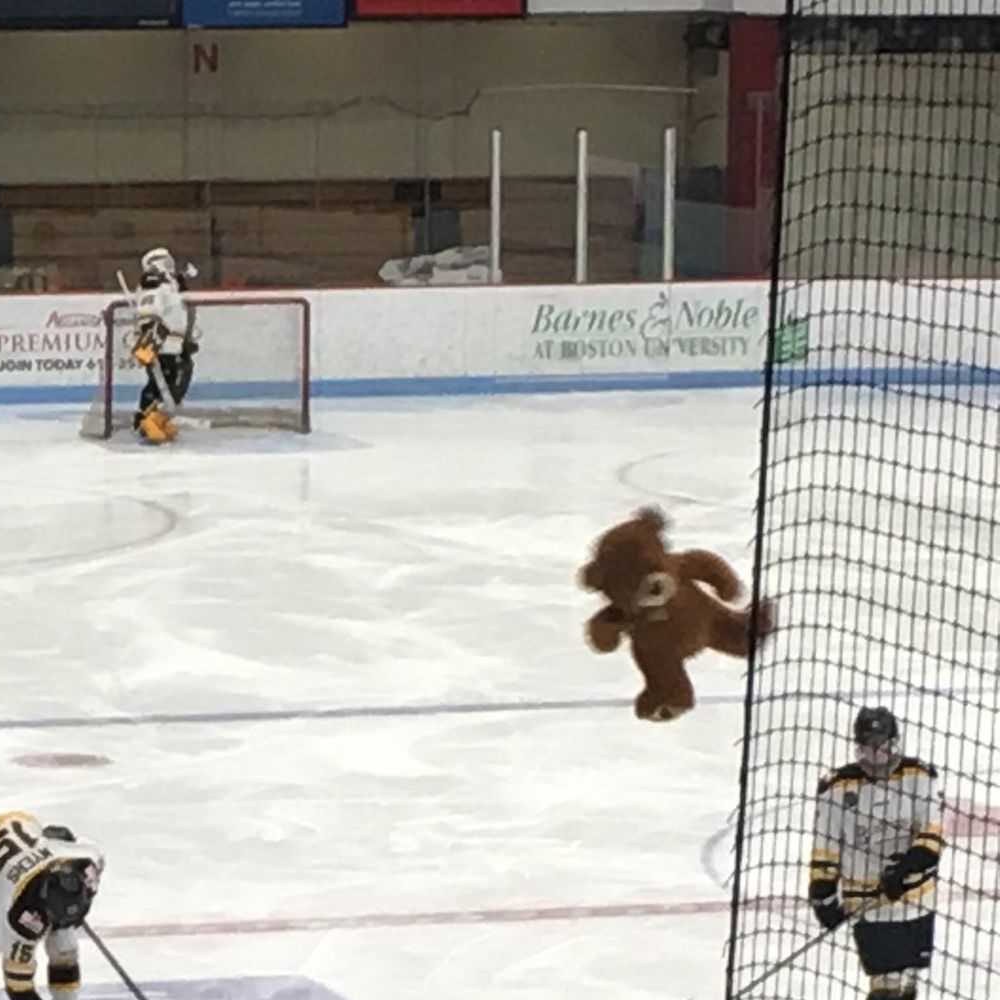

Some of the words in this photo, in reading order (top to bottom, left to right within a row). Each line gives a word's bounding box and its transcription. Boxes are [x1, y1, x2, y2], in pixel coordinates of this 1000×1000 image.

[192, 43, 218, 73] N
[532, 303, 638, 334] Barnes
[674, 299, 759, 332] Noble
[534, 341, 552, 359] AT
[559, 340, 635, 359] BOSTON
[36, 358, 83, 371] TODAY
